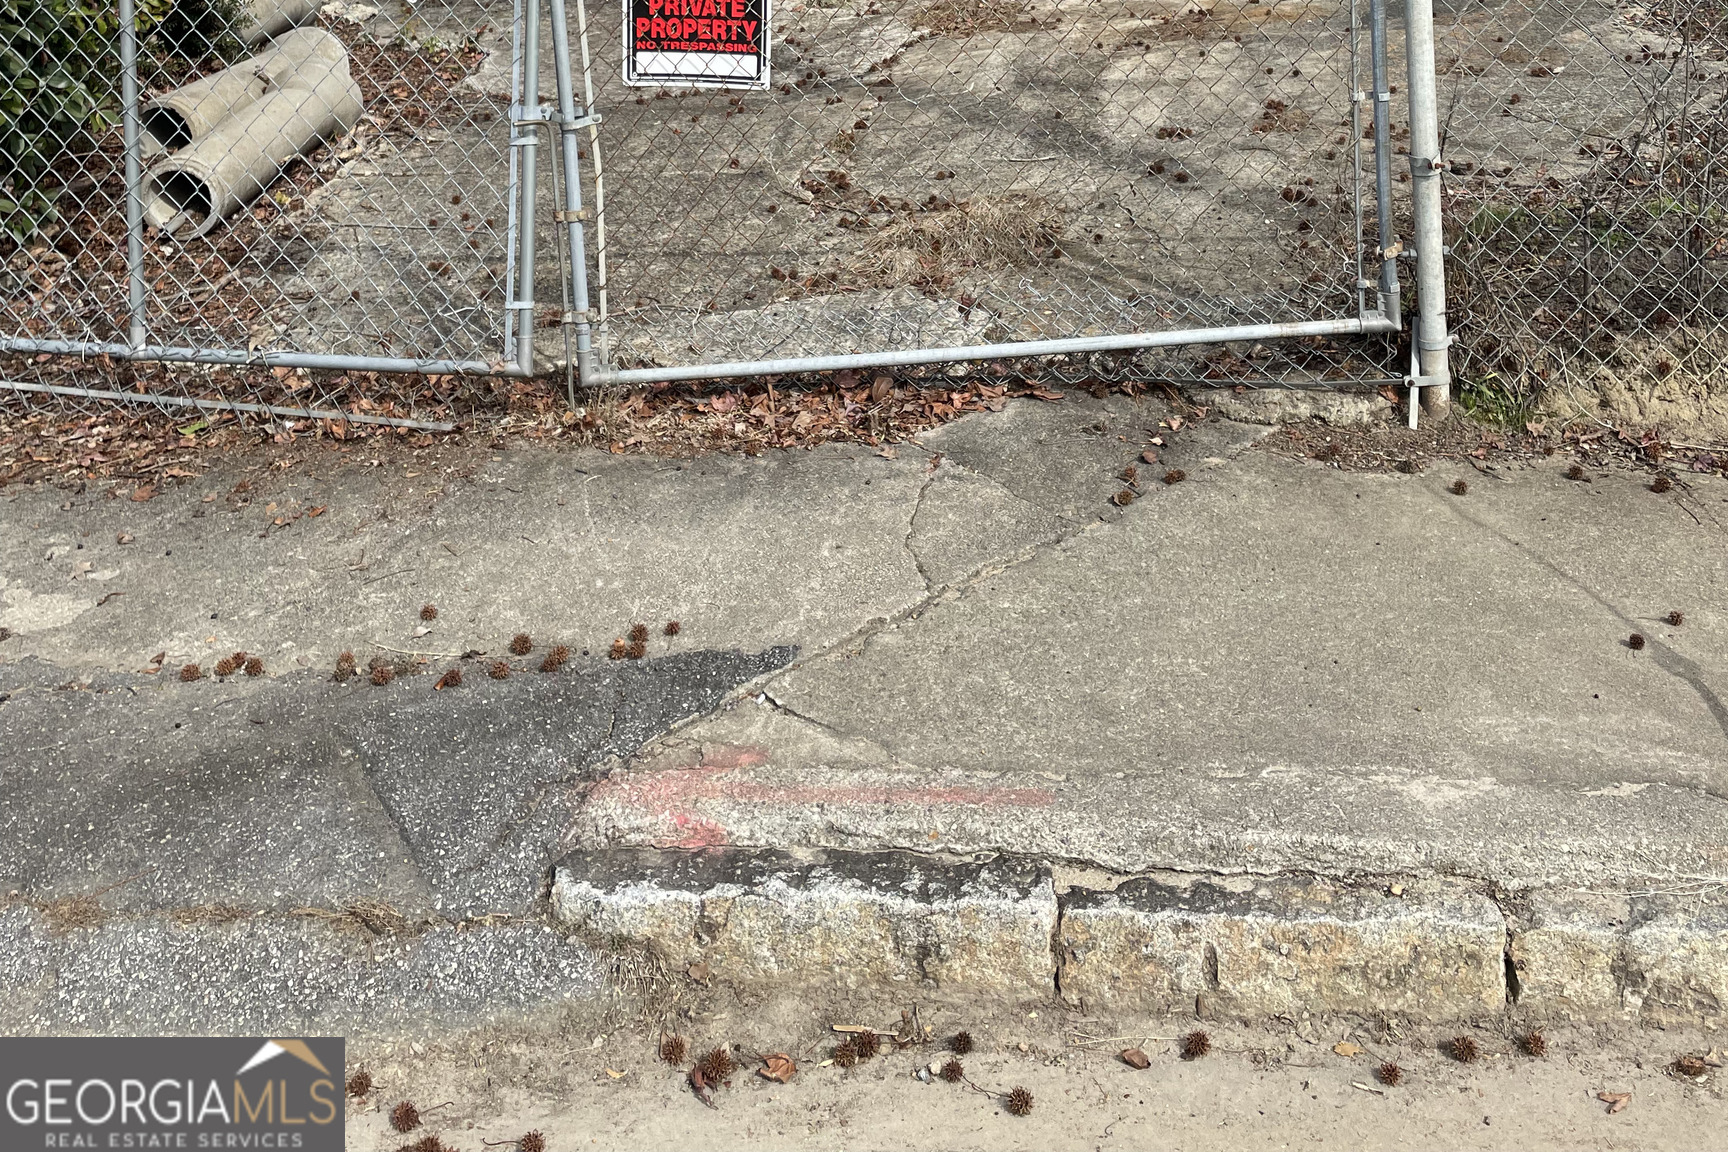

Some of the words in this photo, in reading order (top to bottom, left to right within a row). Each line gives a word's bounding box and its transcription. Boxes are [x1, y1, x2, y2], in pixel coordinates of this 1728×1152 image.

[636, 17, 758, 41] PROPERTY
[636, 41, 656, 50] NO
[661, 41, 758, 53] TRESPASSING
